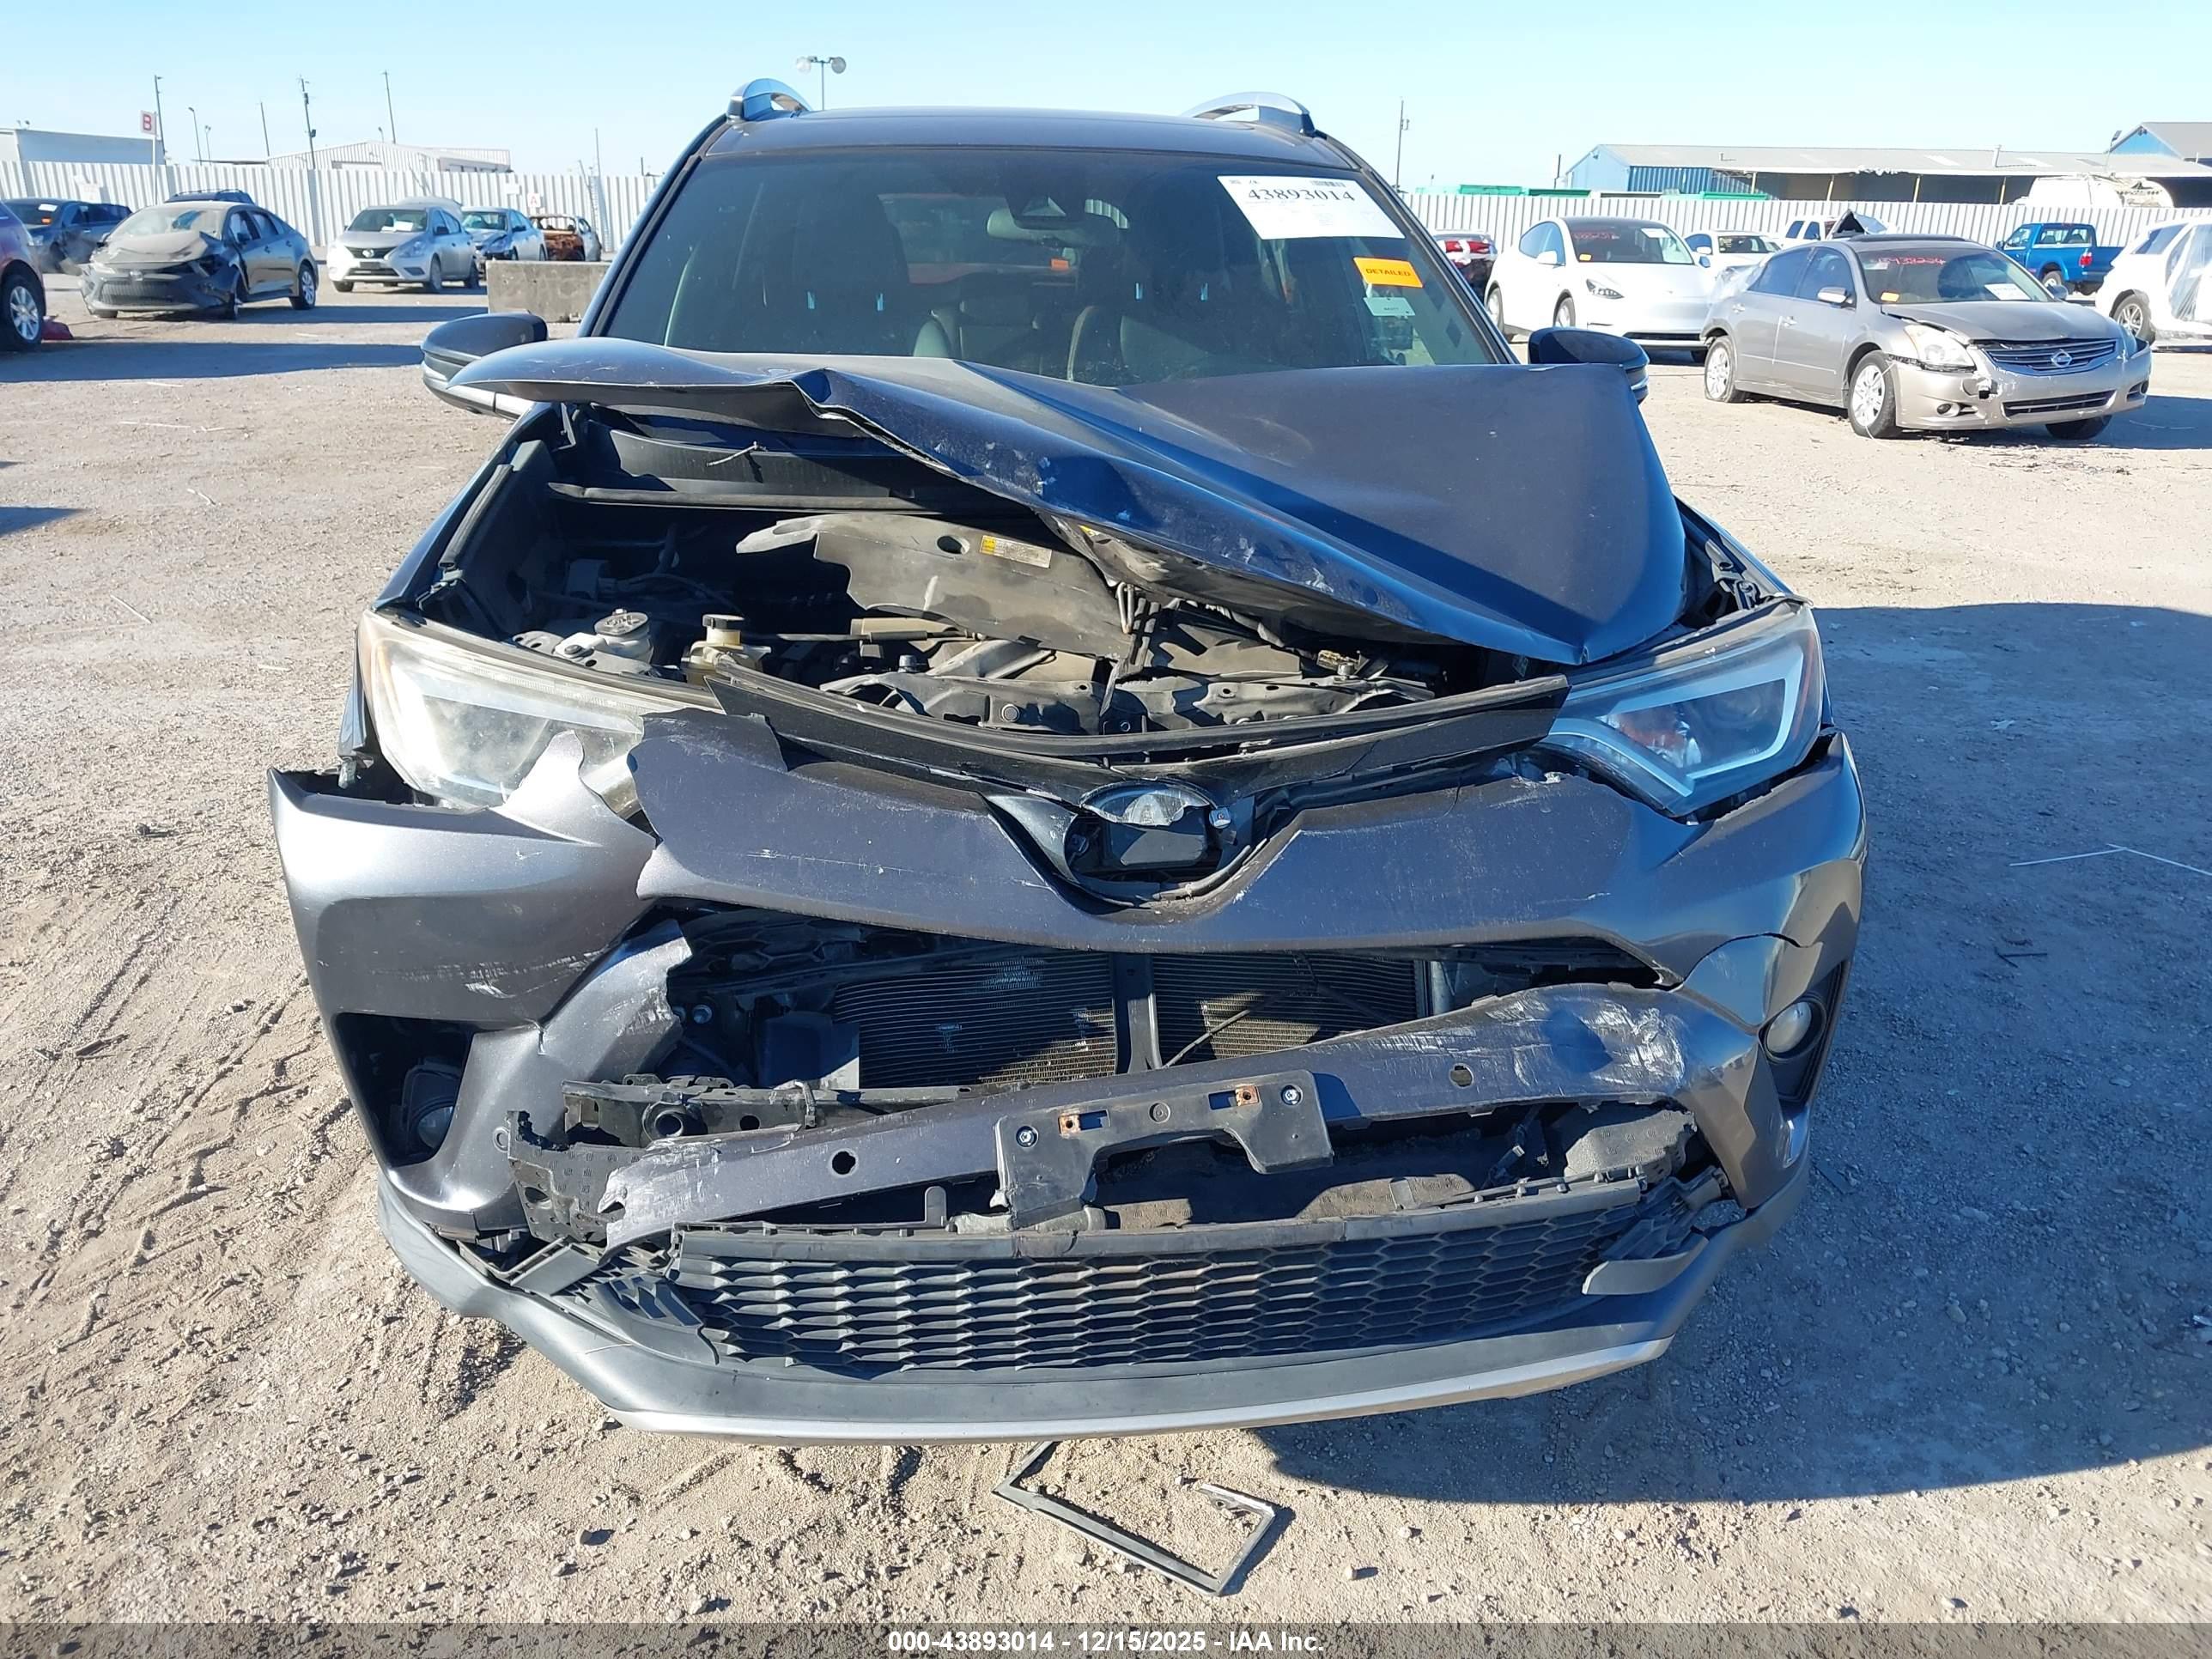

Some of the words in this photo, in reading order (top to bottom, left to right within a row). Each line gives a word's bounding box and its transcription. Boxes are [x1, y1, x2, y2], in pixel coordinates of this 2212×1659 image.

[143, 114, 152, 131] B
[1249, 189, 1355, 203] 43893014
[1365, 268, 1411, 276] DETAILED
